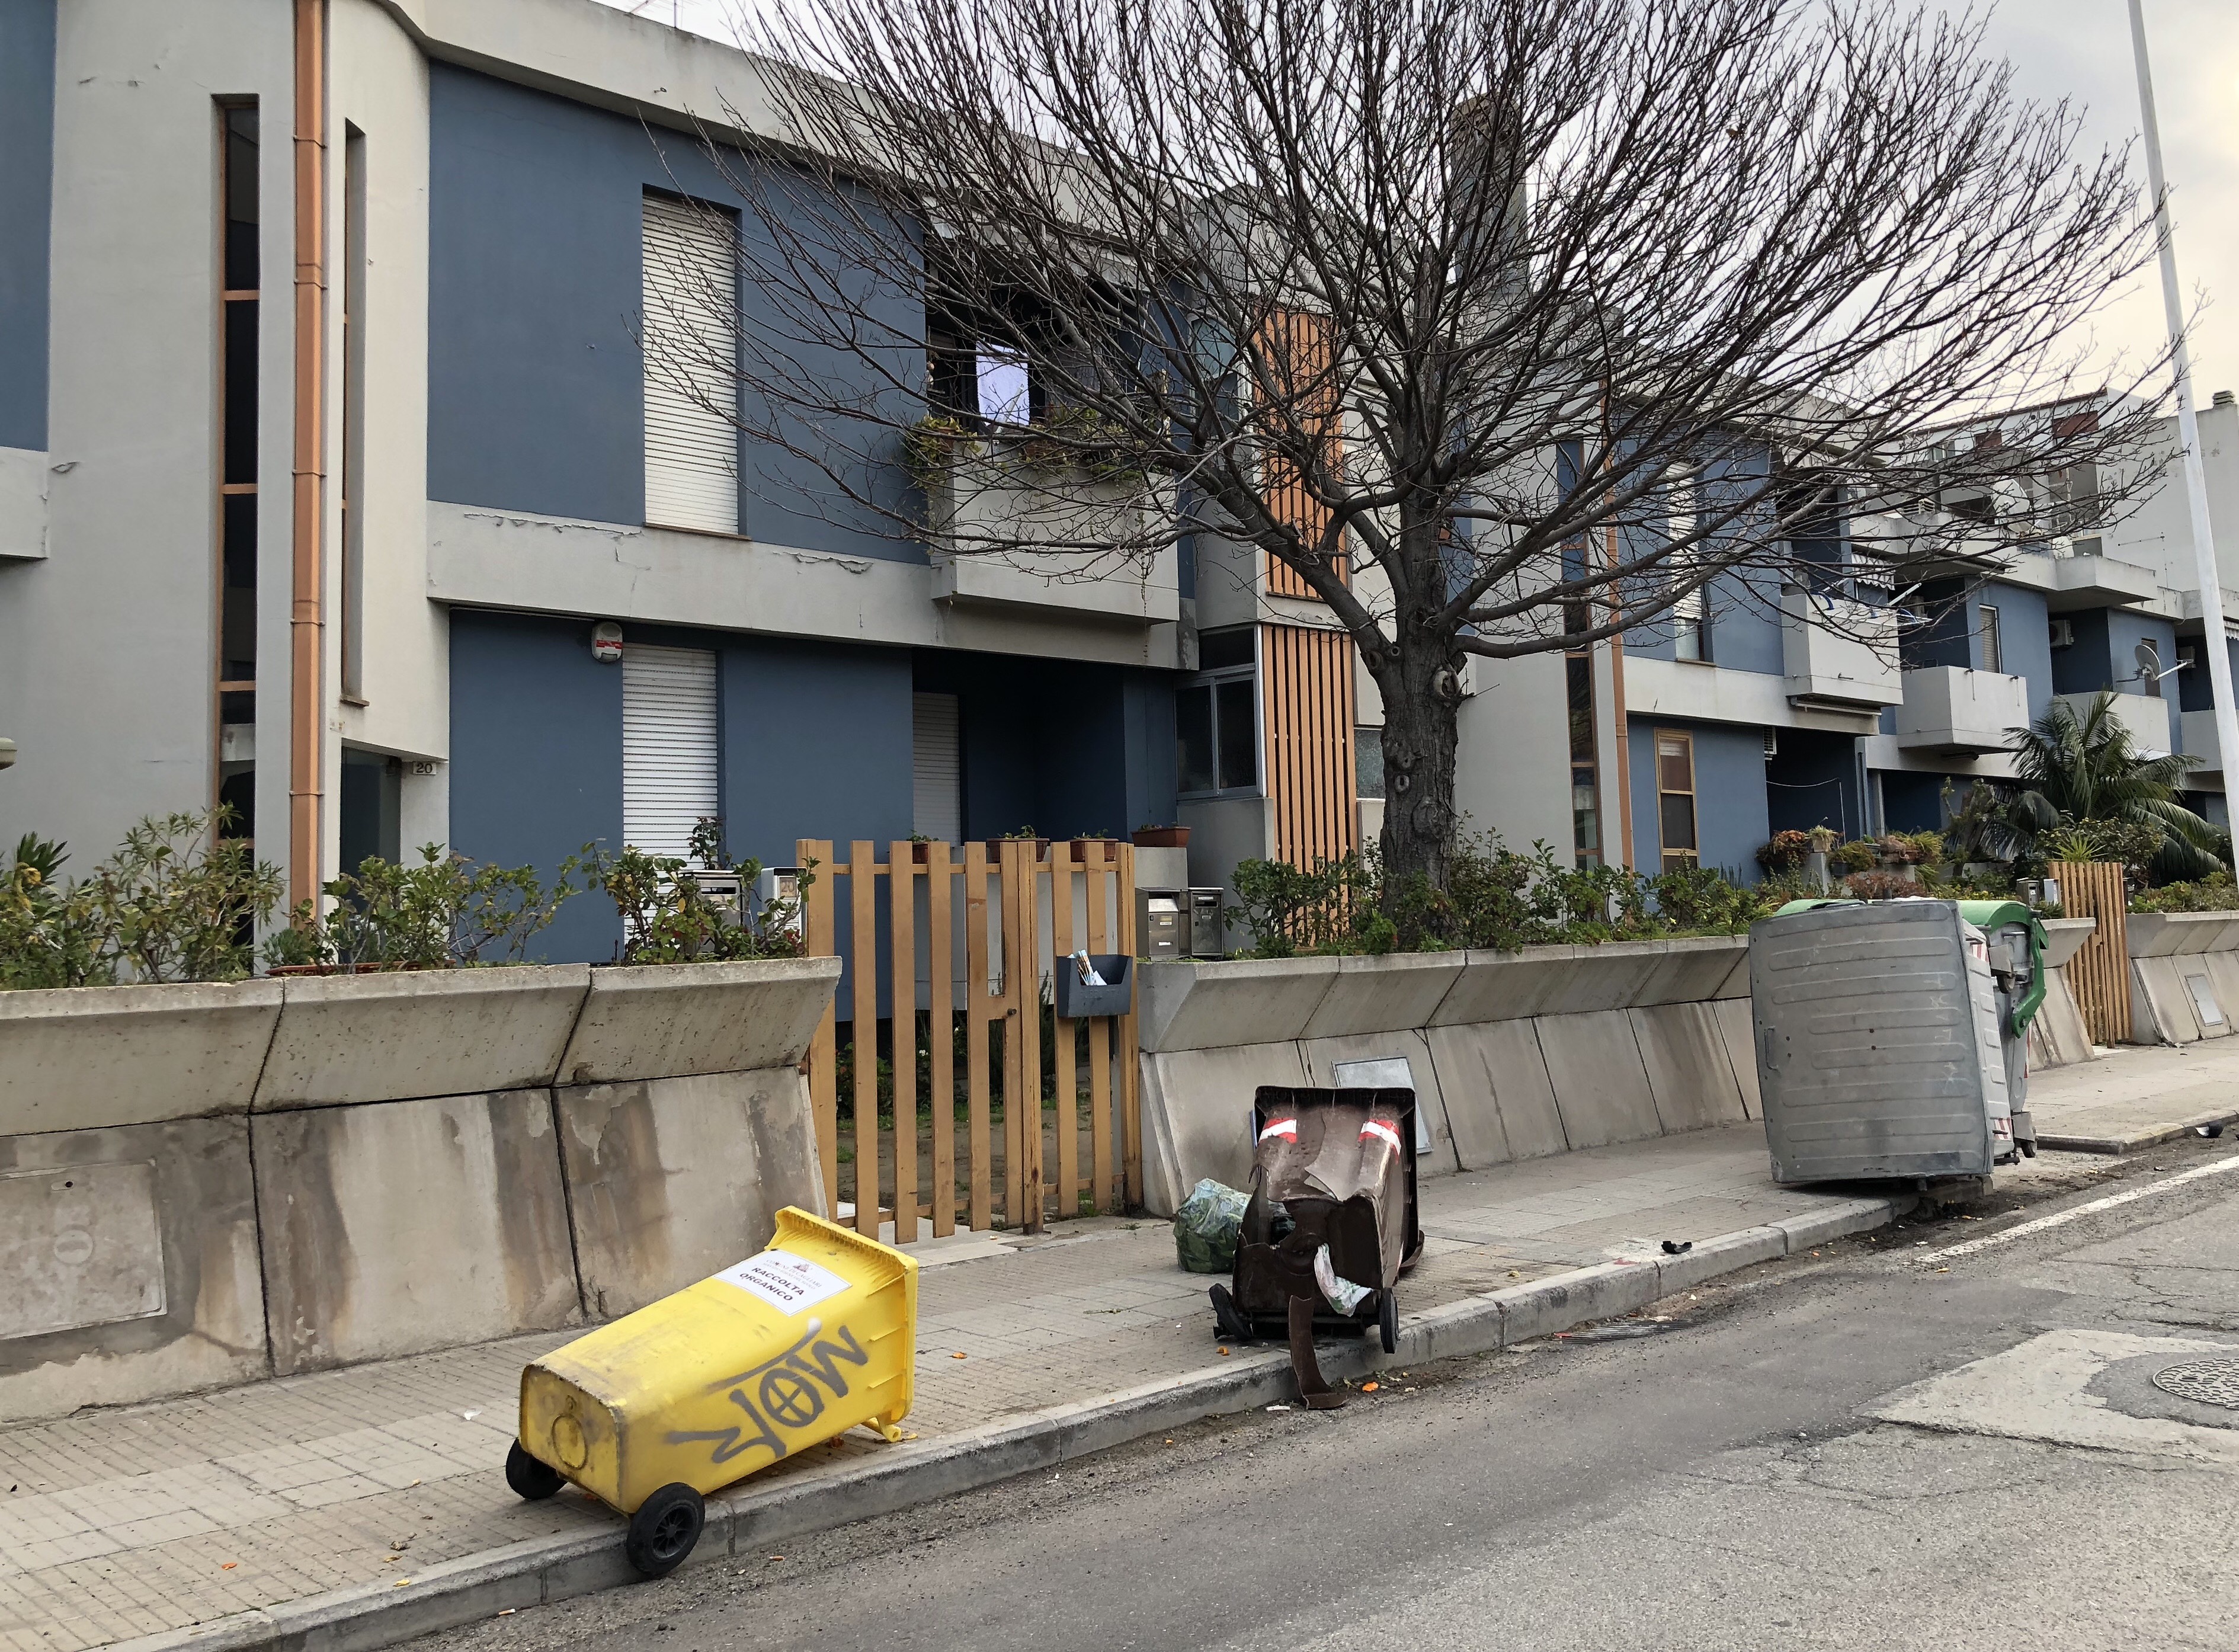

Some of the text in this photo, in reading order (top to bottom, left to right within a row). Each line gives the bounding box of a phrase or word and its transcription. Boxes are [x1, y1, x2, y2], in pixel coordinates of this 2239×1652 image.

[417, 763, 433, 773] 20
[781, 881, 795, 893] 20
[739, 1273, 793, 1301] ORGANICO
[751, 1267, 804, 1295] RACCOLTA
[795, 1271, 822, 1288] CAGLIARI
